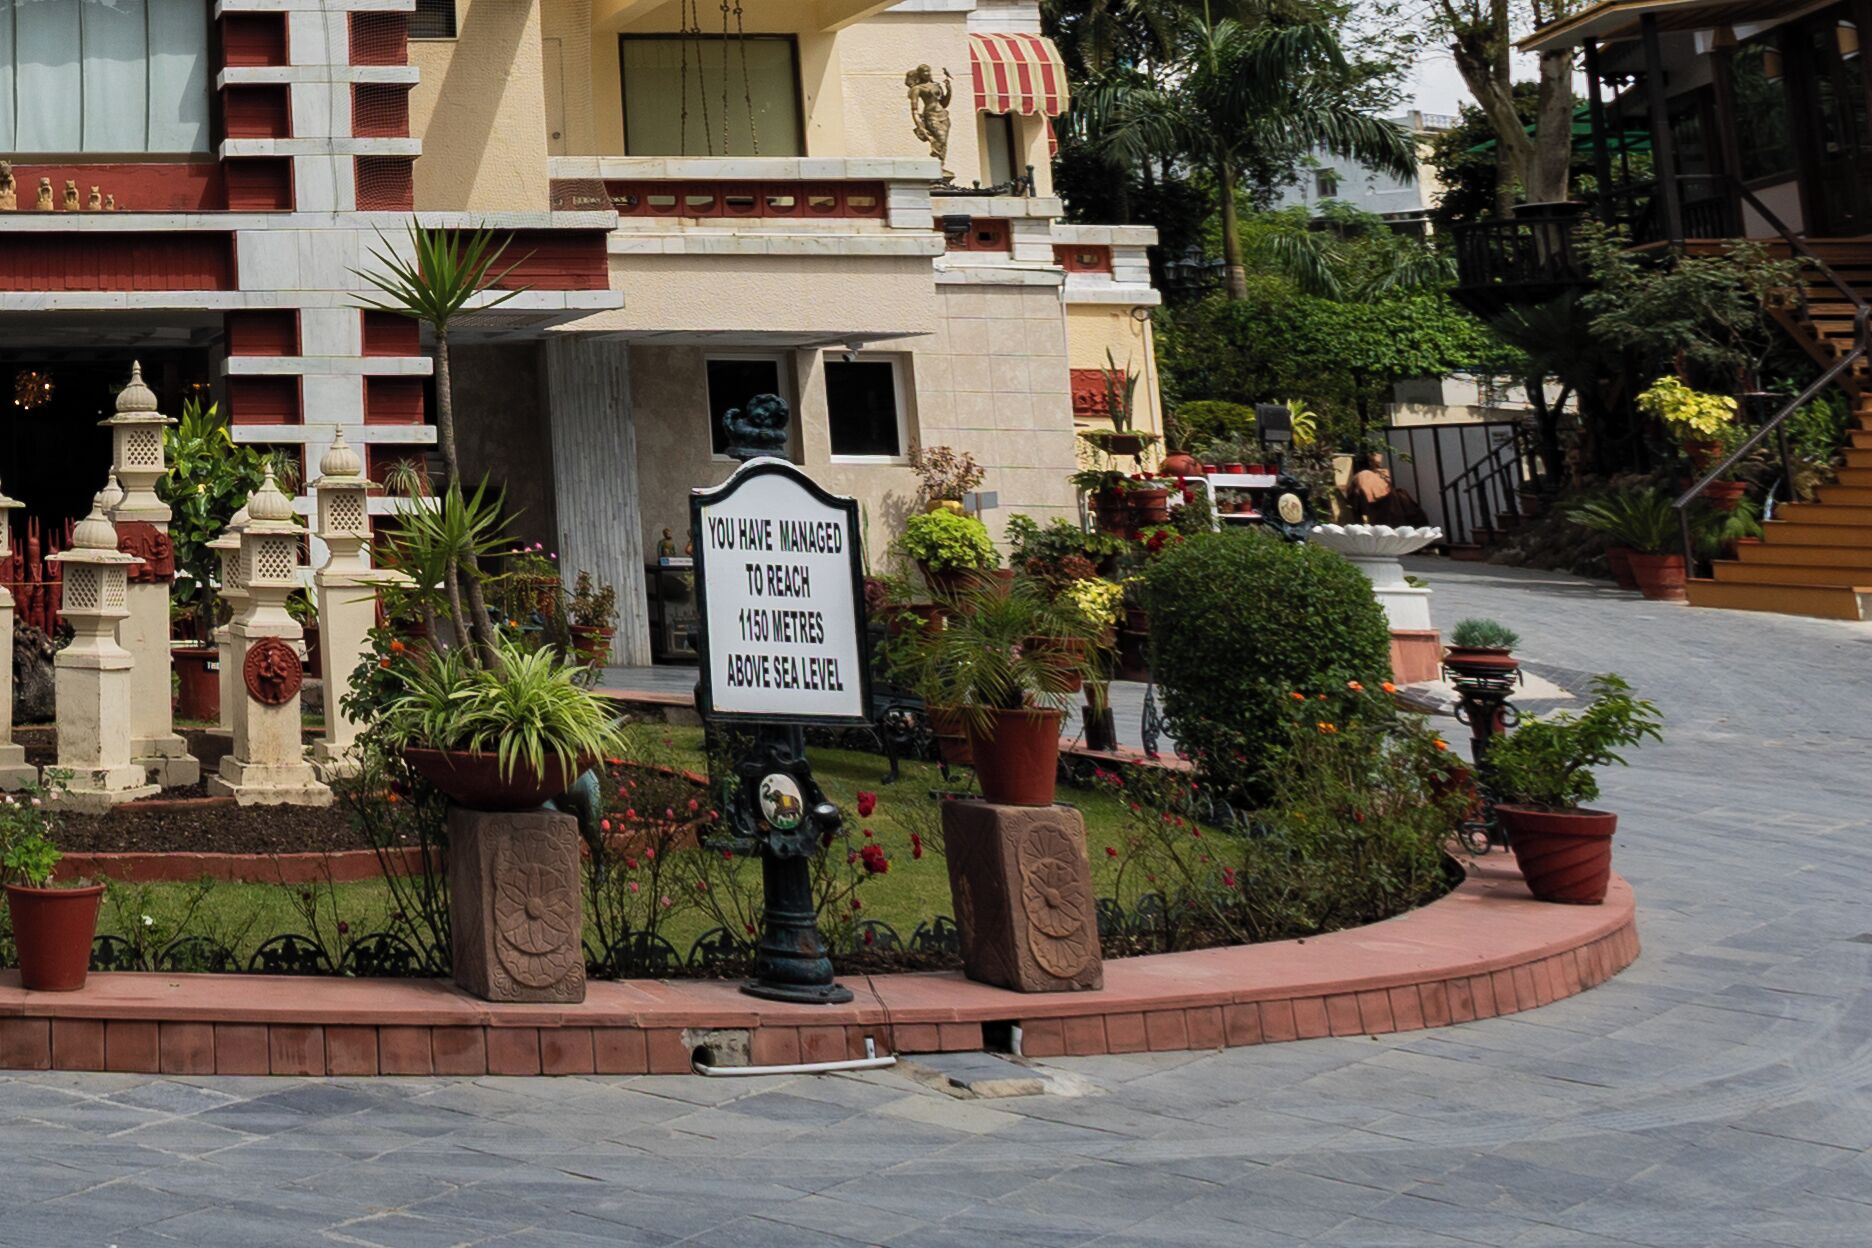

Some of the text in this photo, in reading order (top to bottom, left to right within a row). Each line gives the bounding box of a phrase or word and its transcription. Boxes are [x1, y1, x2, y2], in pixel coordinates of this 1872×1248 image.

[708, 516, 842, 554] YOU HAVE MANAGED
[745, 563, 811, 598] TO REACH
[738, 608, 825, 645] 1150 METRES
[727, 653, 844, 692] ABOVE SEA LEVEL
